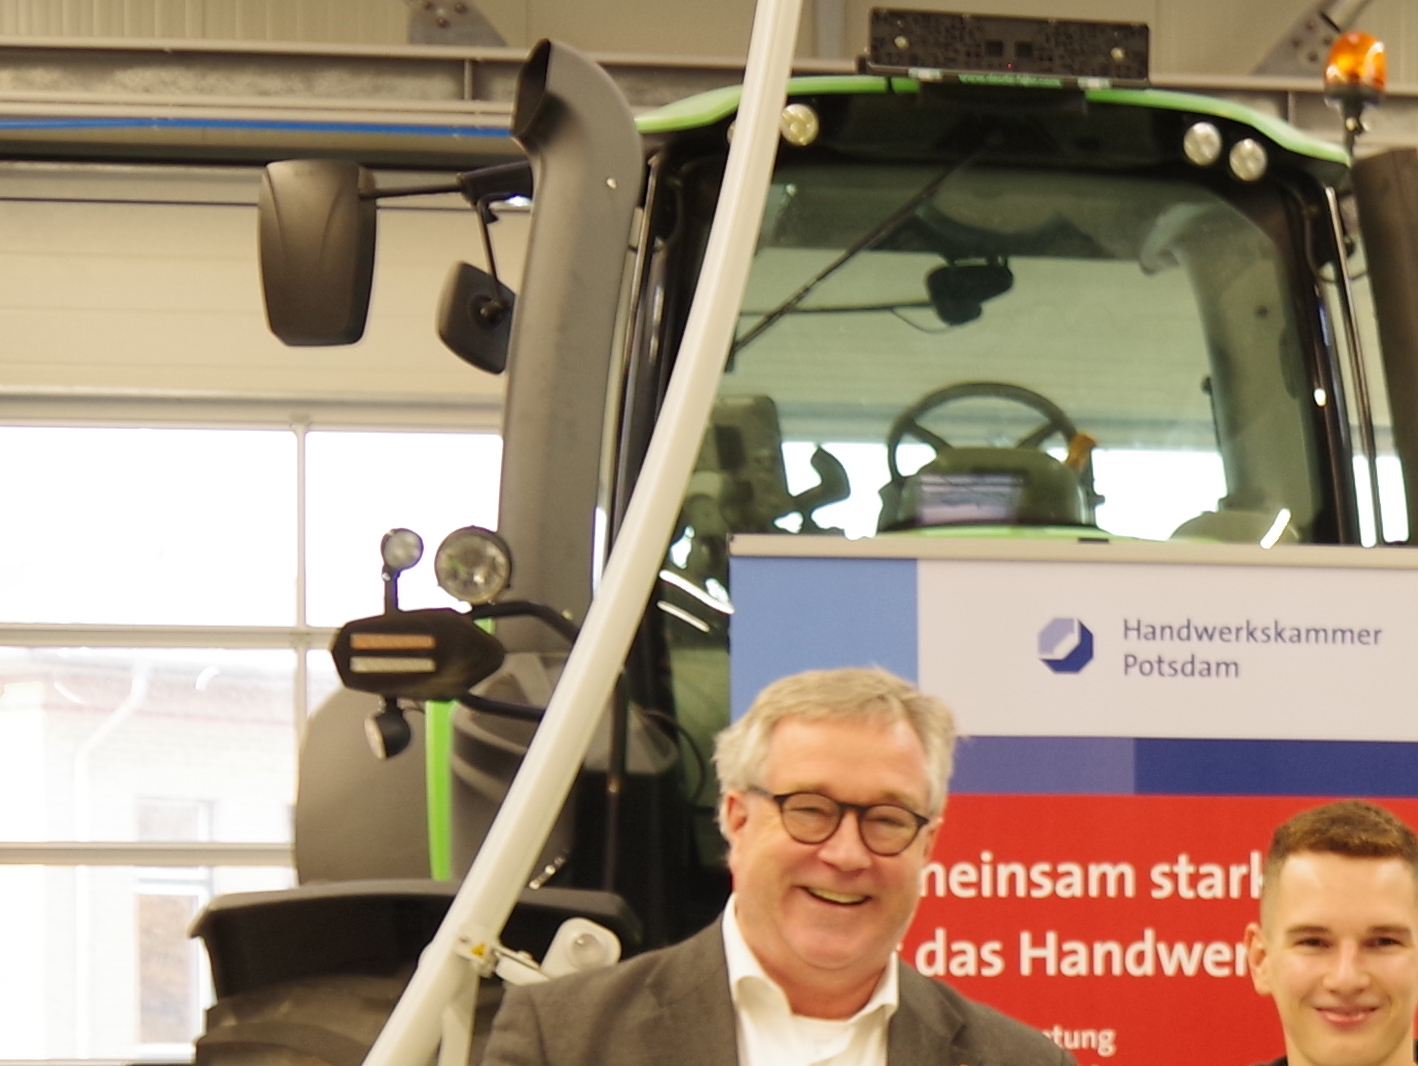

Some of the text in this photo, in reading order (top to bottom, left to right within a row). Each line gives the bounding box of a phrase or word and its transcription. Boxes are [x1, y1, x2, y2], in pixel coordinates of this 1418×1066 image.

[1122, 618, 1383, 646] Handwerkskammer
[1123, 653, 1240, 678] Potsdam
[915, 927, 1249, 978] das Handwer
